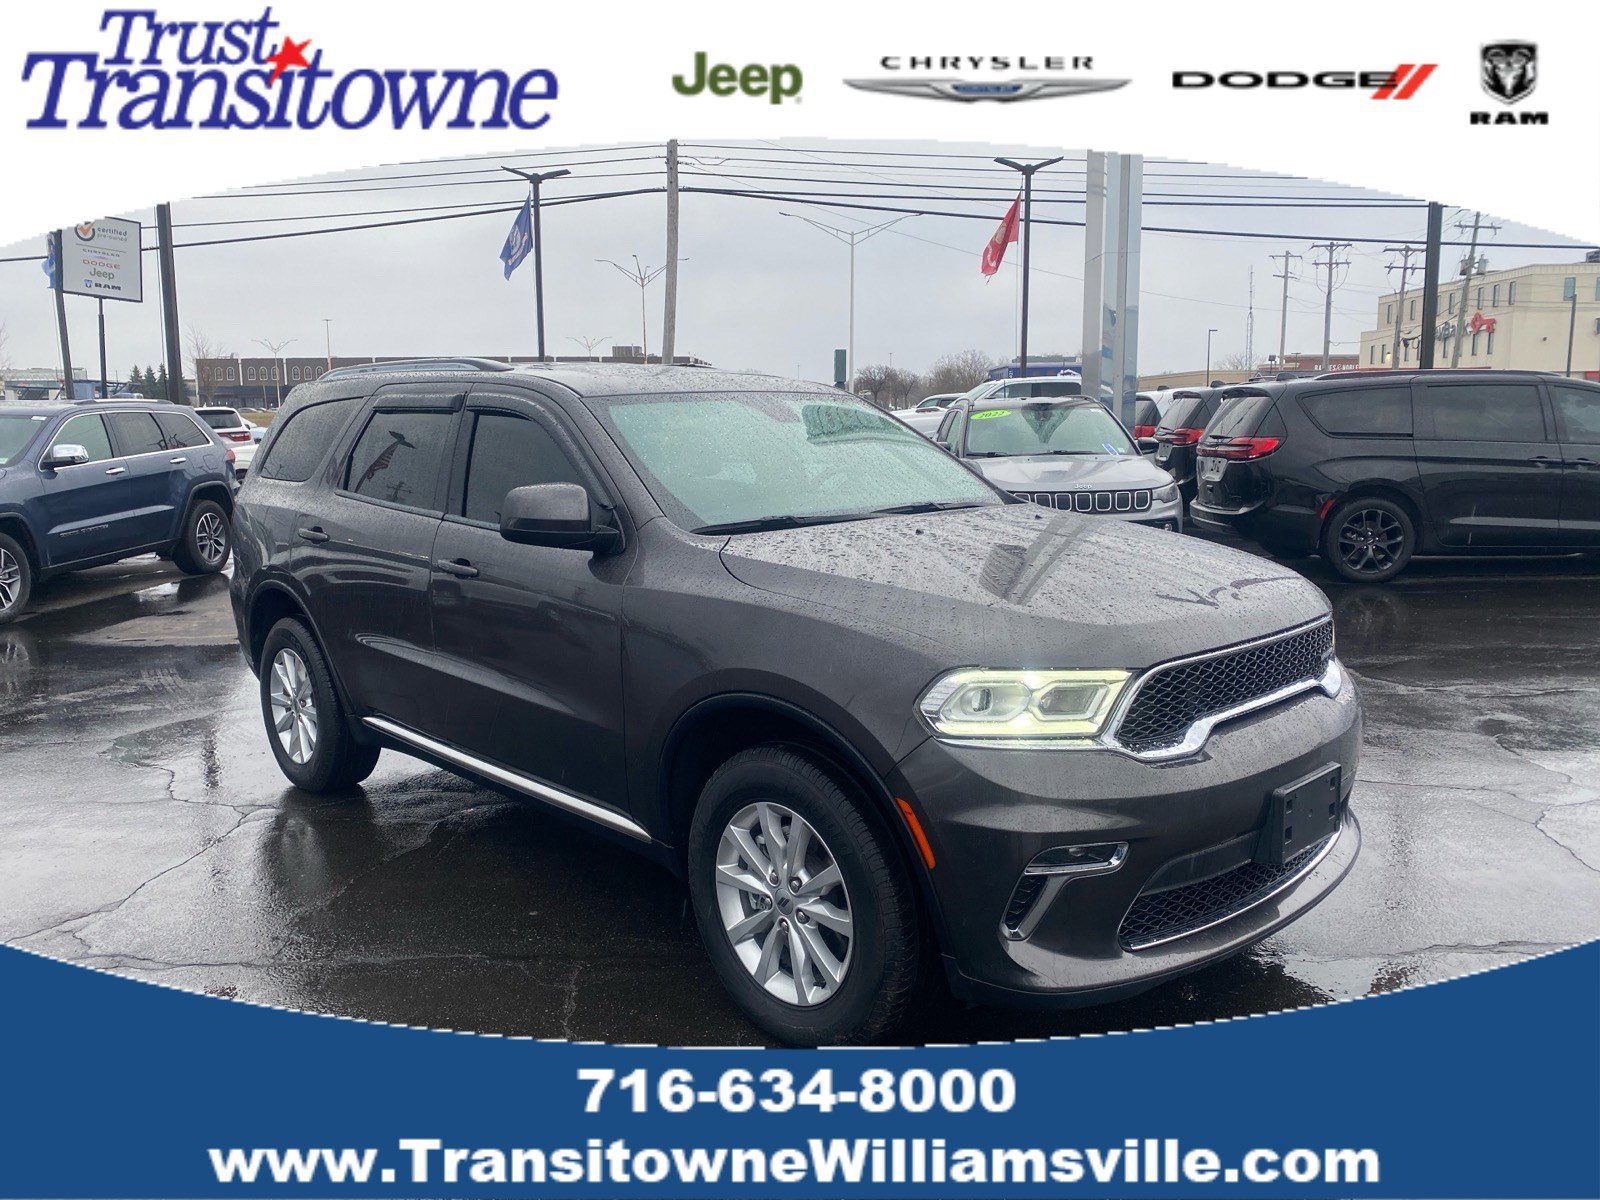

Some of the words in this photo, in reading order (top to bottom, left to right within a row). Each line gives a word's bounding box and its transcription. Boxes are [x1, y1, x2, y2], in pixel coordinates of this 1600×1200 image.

[97, 226, 128, 237] certified
[82, 248, 120, 258] CHRYSLER
[82, 259, 121, 269] DODGE
[89, 267, 115, 280] Jeep
[94, 282, 122, 291] RAM
